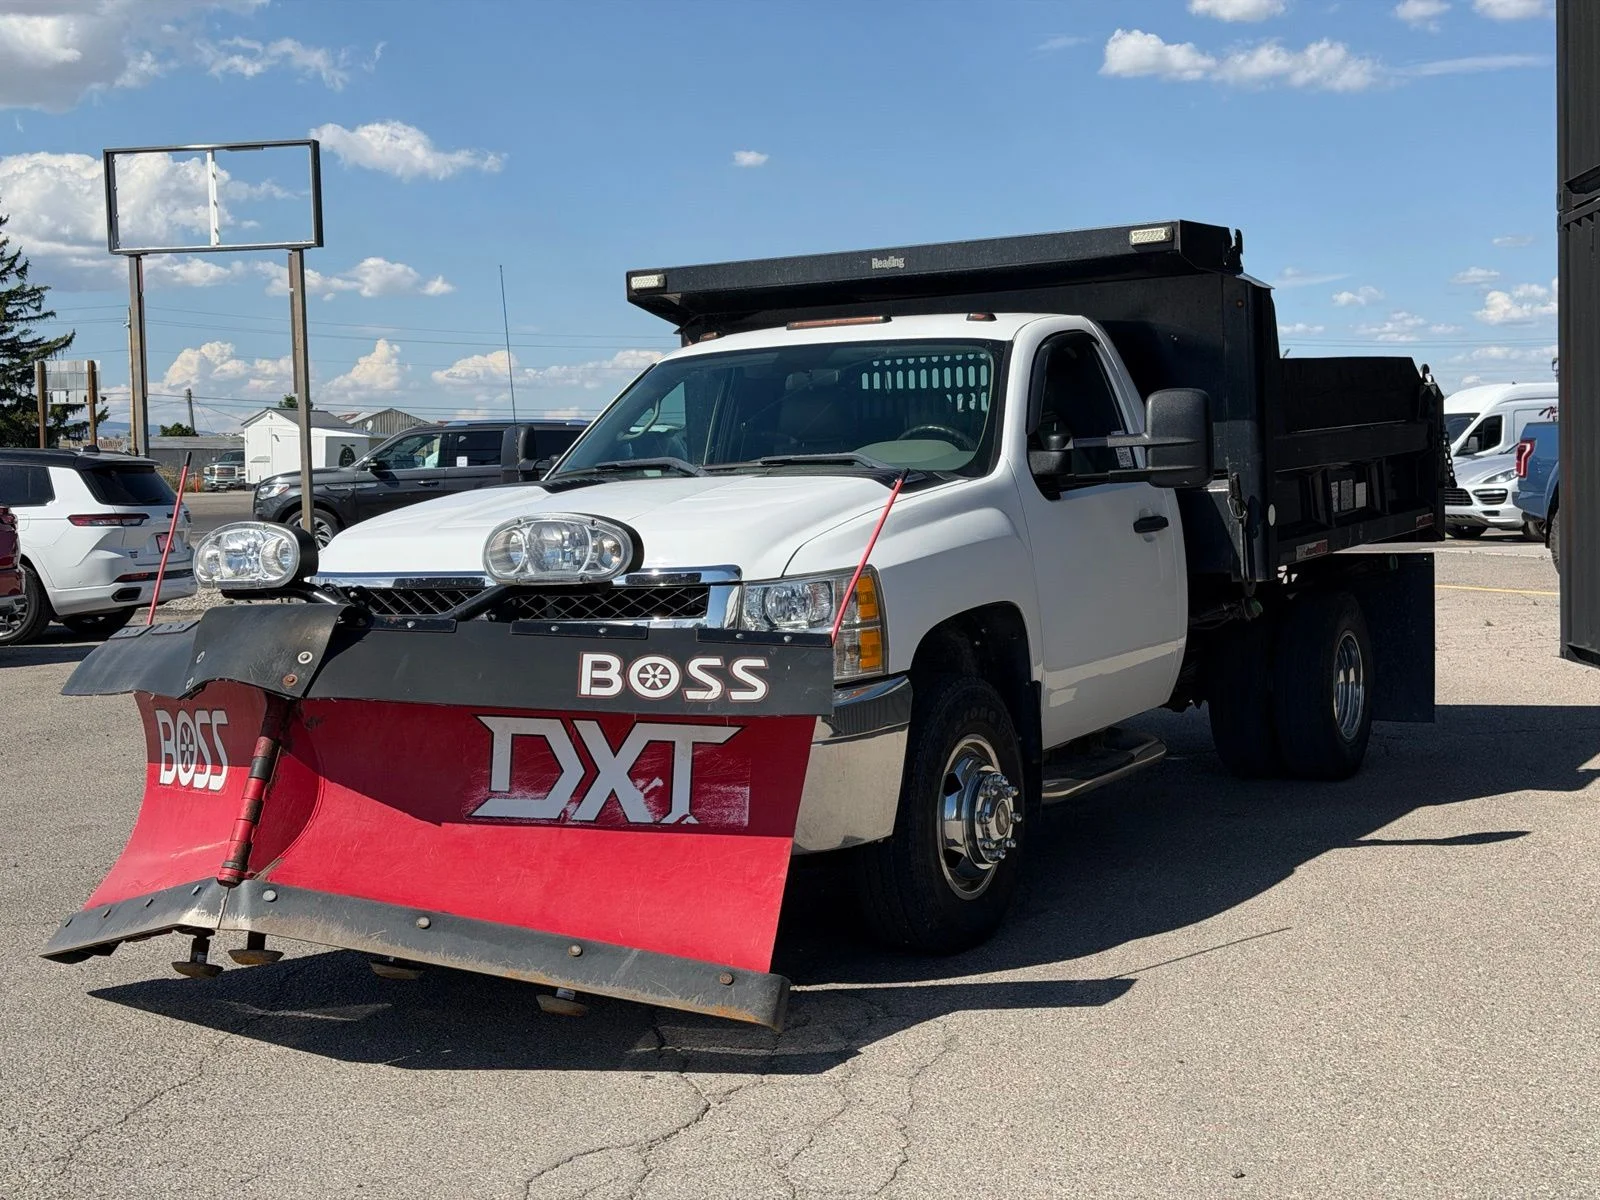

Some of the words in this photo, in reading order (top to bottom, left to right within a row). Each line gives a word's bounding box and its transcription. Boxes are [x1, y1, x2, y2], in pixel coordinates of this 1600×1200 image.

[578, 652, 769, 702] BOSS
[155, 709, 229, 791] BOSS
[469, 714, 745, 825] DXT
